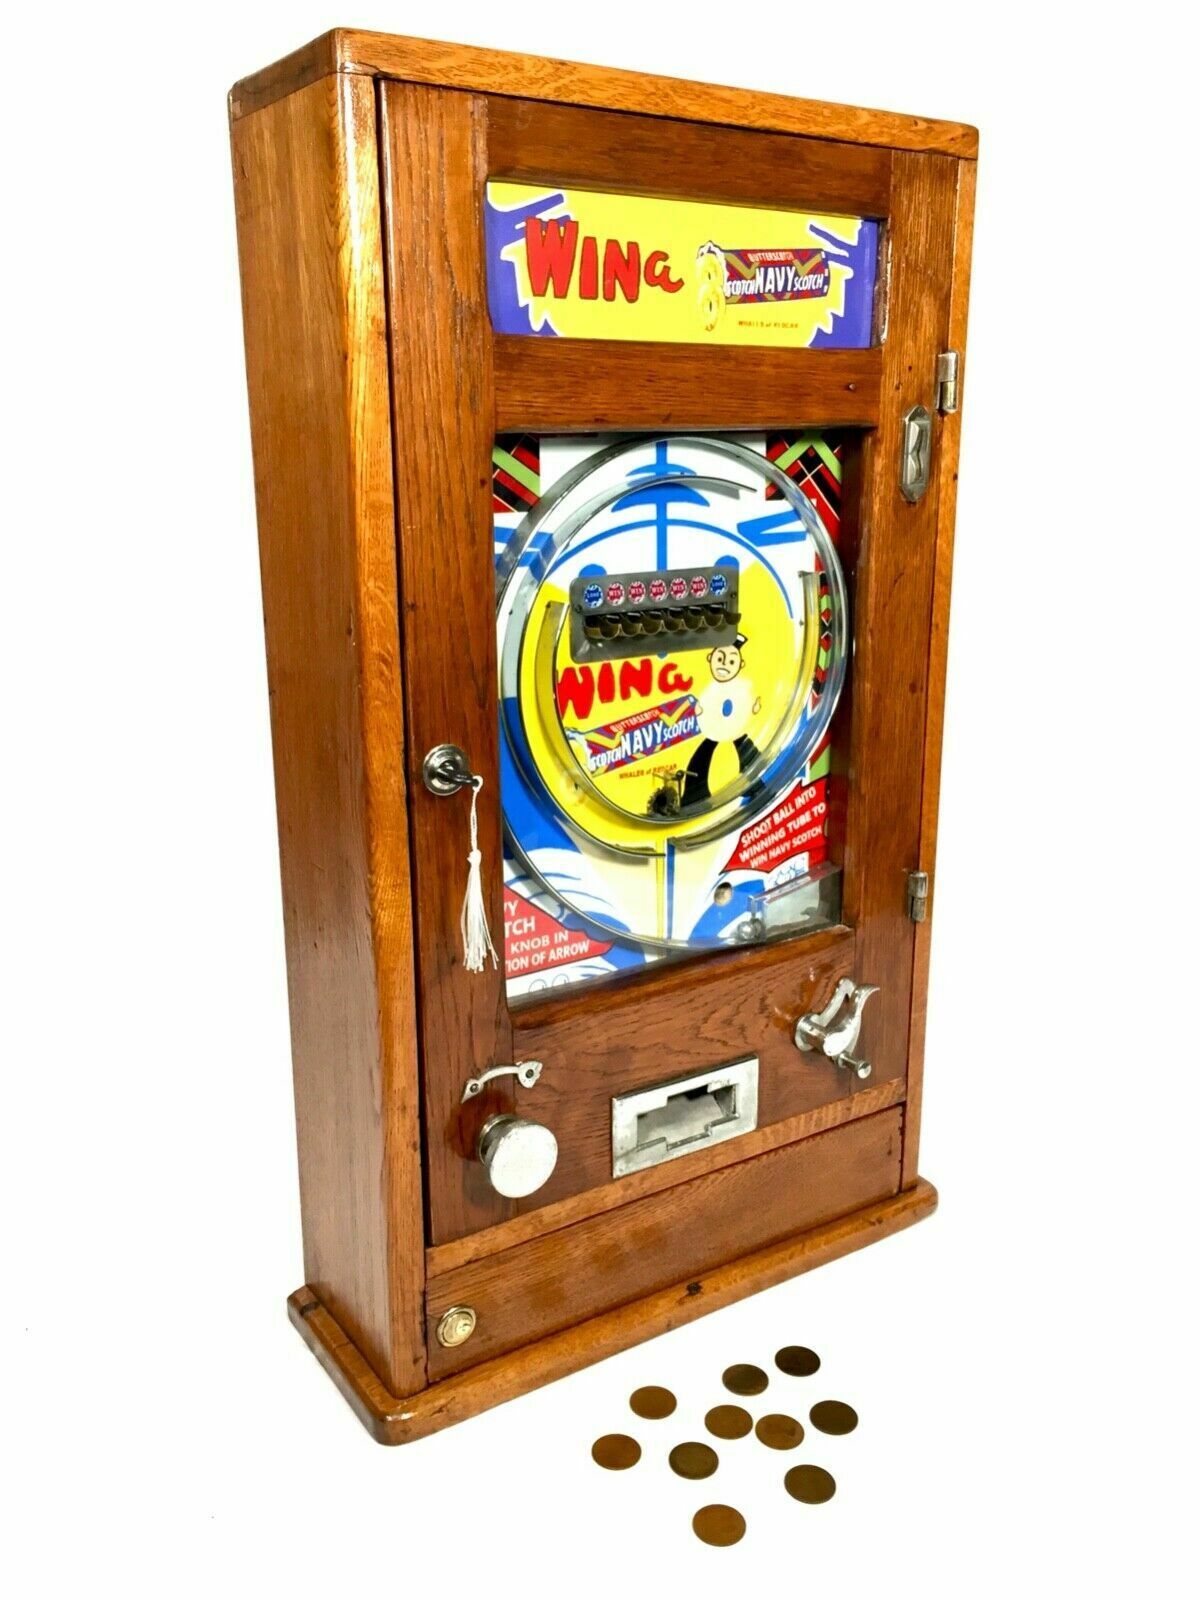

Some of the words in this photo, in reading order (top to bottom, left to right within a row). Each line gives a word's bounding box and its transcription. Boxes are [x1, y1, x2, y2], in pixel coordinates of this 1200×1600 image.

[725, 279, 758, 298] SCOTCH
[755, 266, 796, 294] NAVY
[794, 273, 825, 292] SCOTCH
[590, 746, 622, 773] SCOTCH
[619, 720, 664, 759] NAVY
[662, 714, 695, 742] SCOTCH
[739, 828, 786, 862] WINNING
[787, 810, 812, 833] TUBE
[812, 803, 826, 818] TO
[741, 817, 772, 847] SHOOT
[773, 804, 795, 826] BALL
[795, 786, 817, 809] INTO
[751, 855, 767, 868] WIN
[768, 839, 791, 859] NAVY
[792, 825, 822, 847] SCOTCH
[510, 934, 550, 955] KNOB
[553, 930, 569, 943] IN
[531, 952, 546, 965] OF
[548, 939, 590, 962] ARROW
